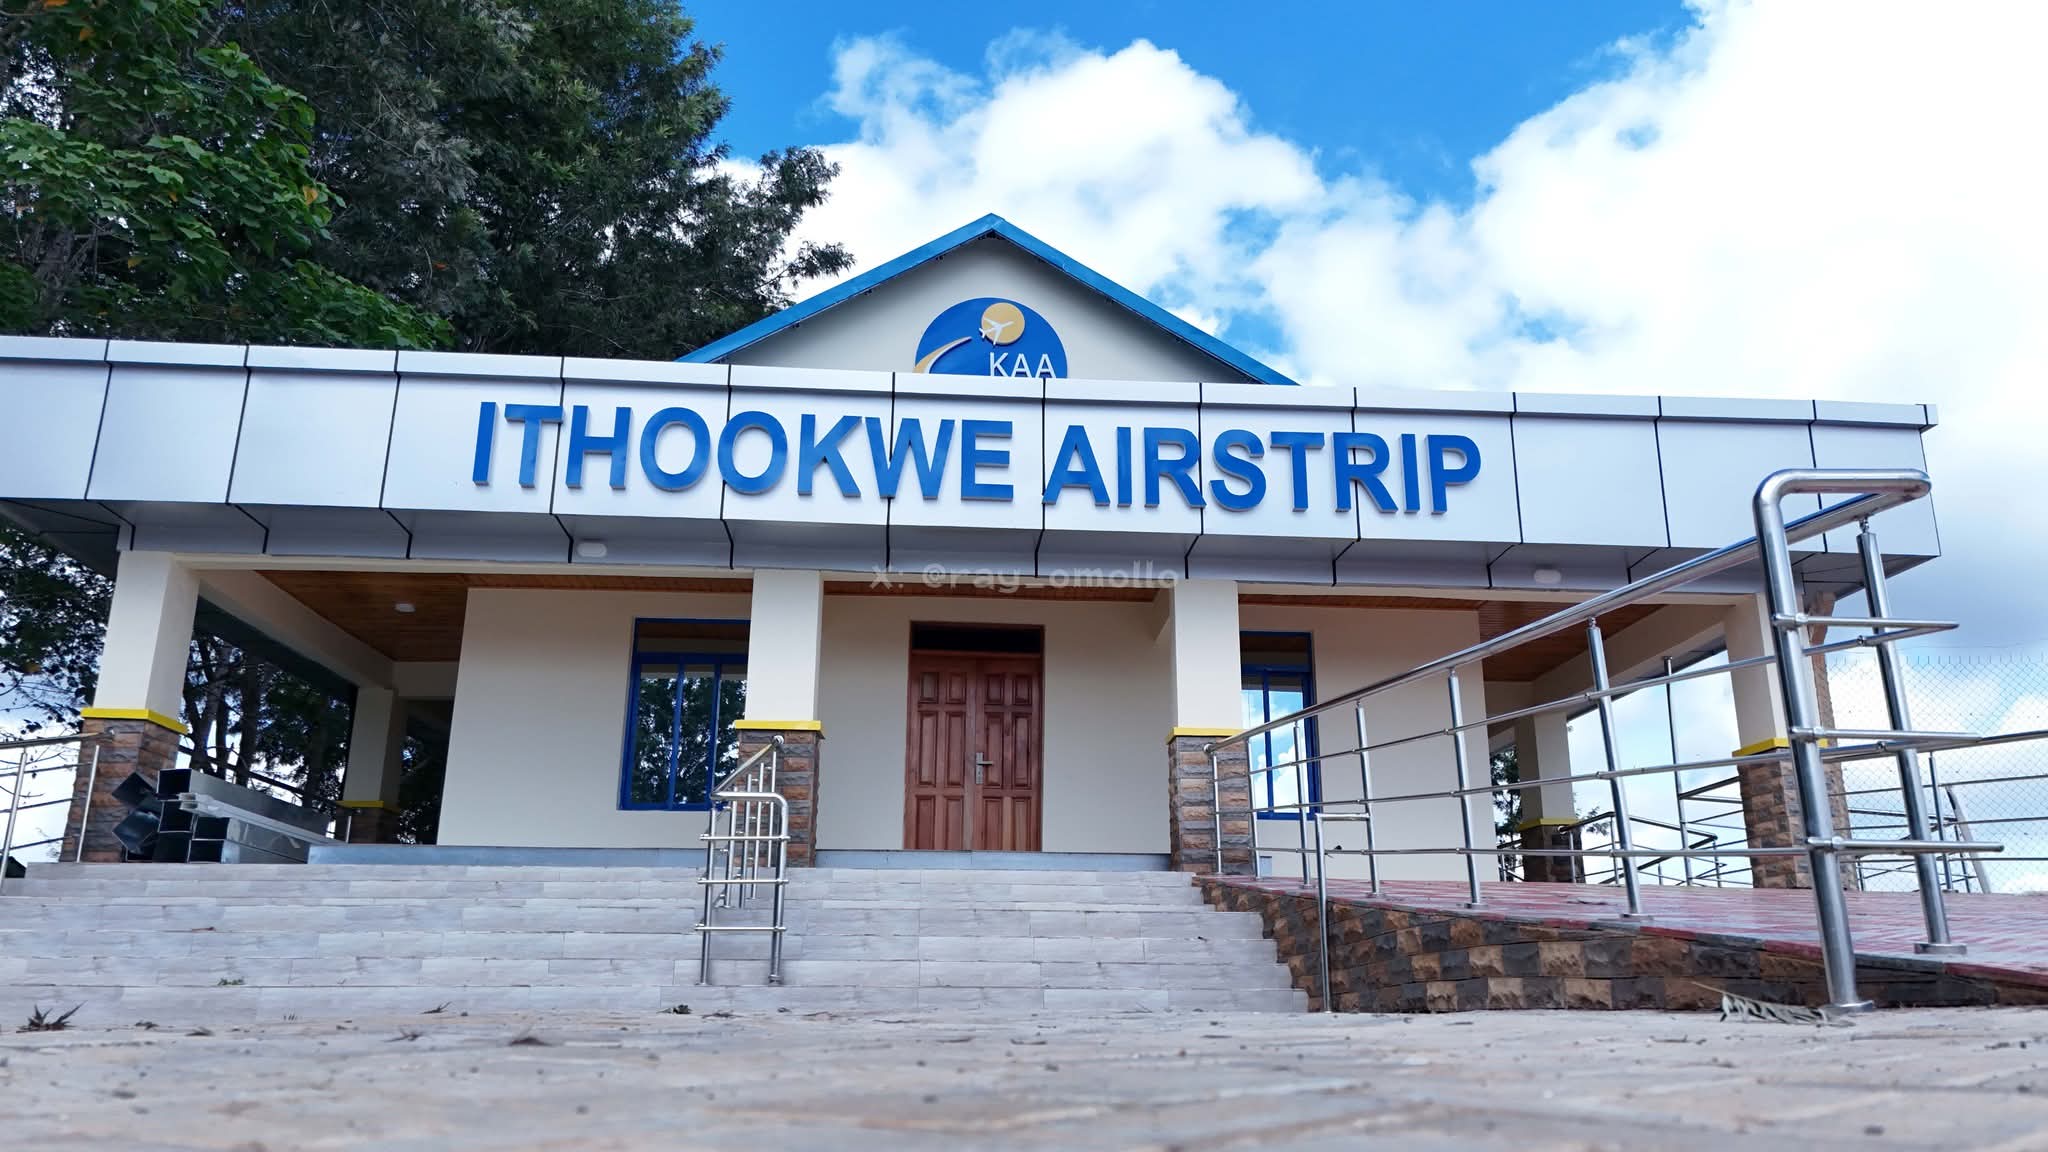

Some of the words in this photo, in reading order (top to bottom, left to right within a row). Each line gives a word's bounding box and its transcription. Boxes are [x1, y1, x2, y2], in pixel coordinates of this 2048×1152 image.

[989, 352, 1056, 378] KAA
[473, 401, 1014, 502] ITHOOKWE
[1042, 424, 1481, 515] AIRSTRIP
